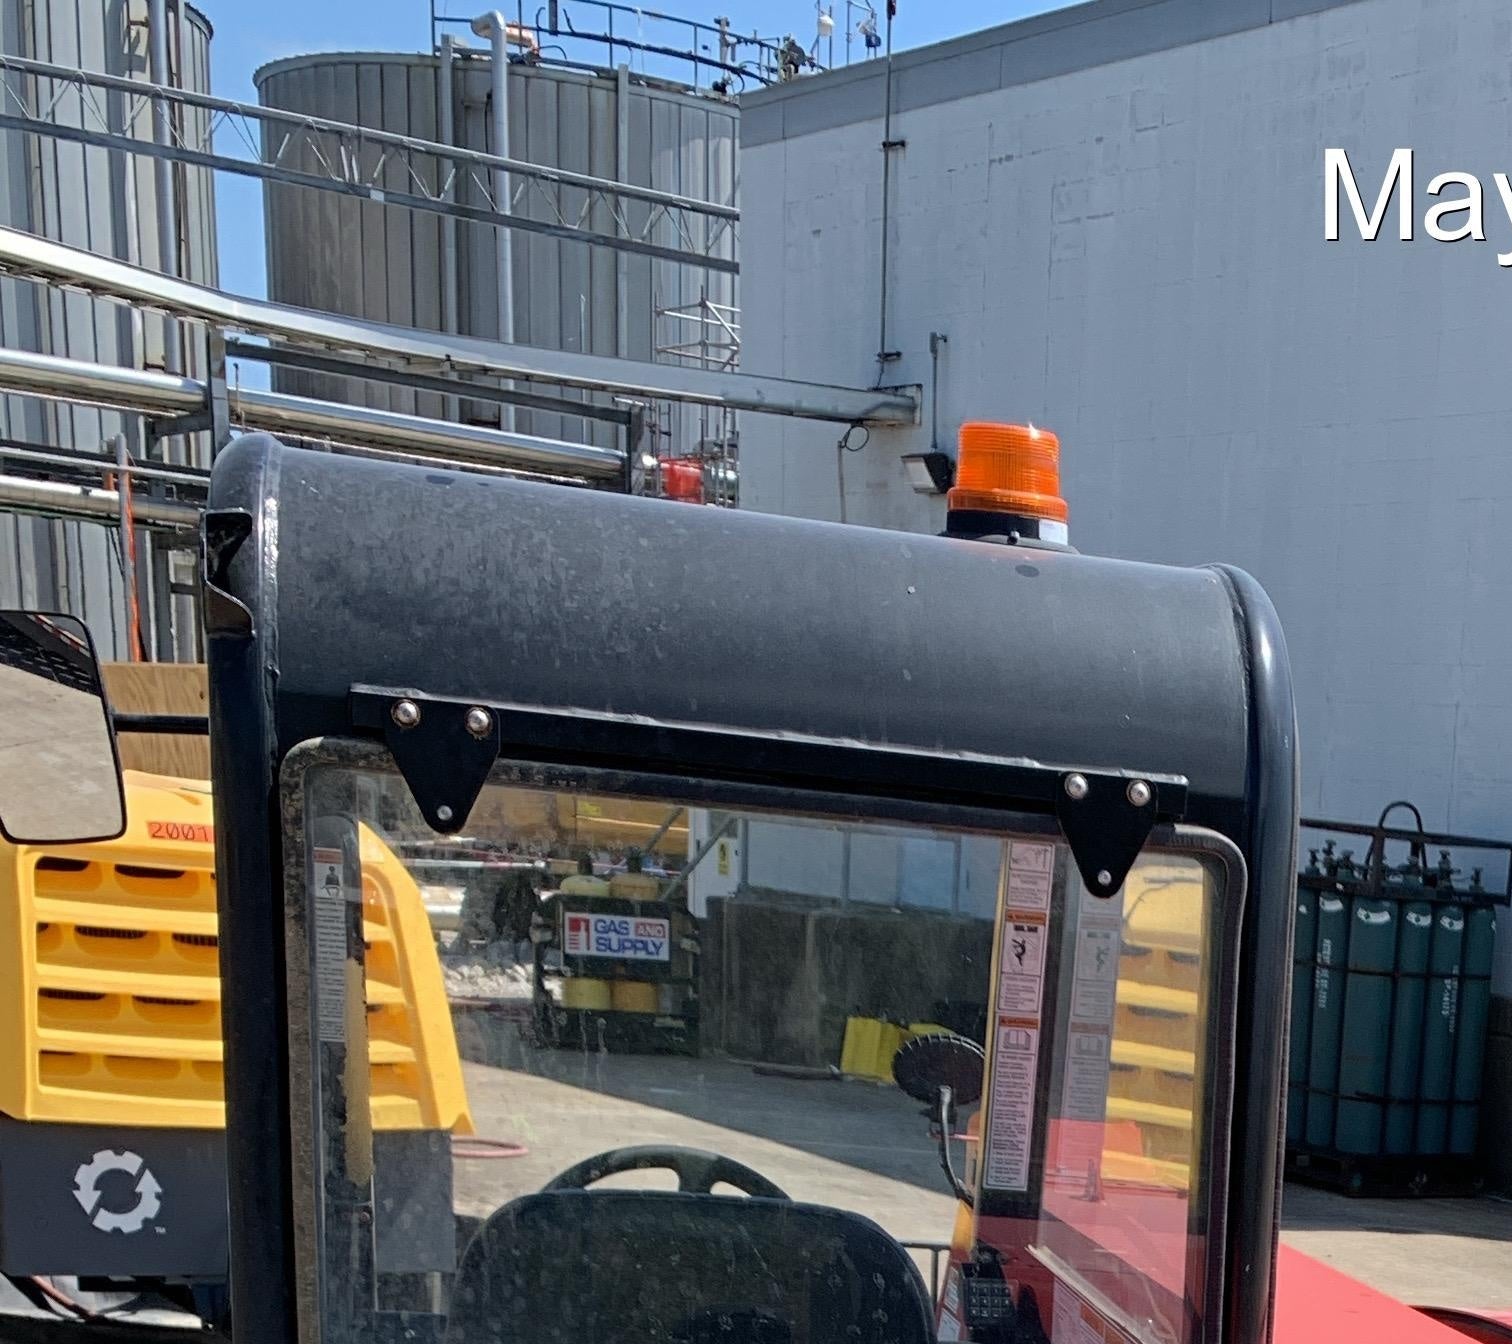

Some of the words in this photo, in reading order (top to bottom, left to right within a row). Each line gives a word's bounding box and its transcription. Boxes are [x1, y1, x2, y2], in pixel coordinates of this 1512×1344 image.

[594, 919, 630, 936] GAS
[638, 923, 665, 938] AND
[595, 936, 663, 956] SUPPLY
